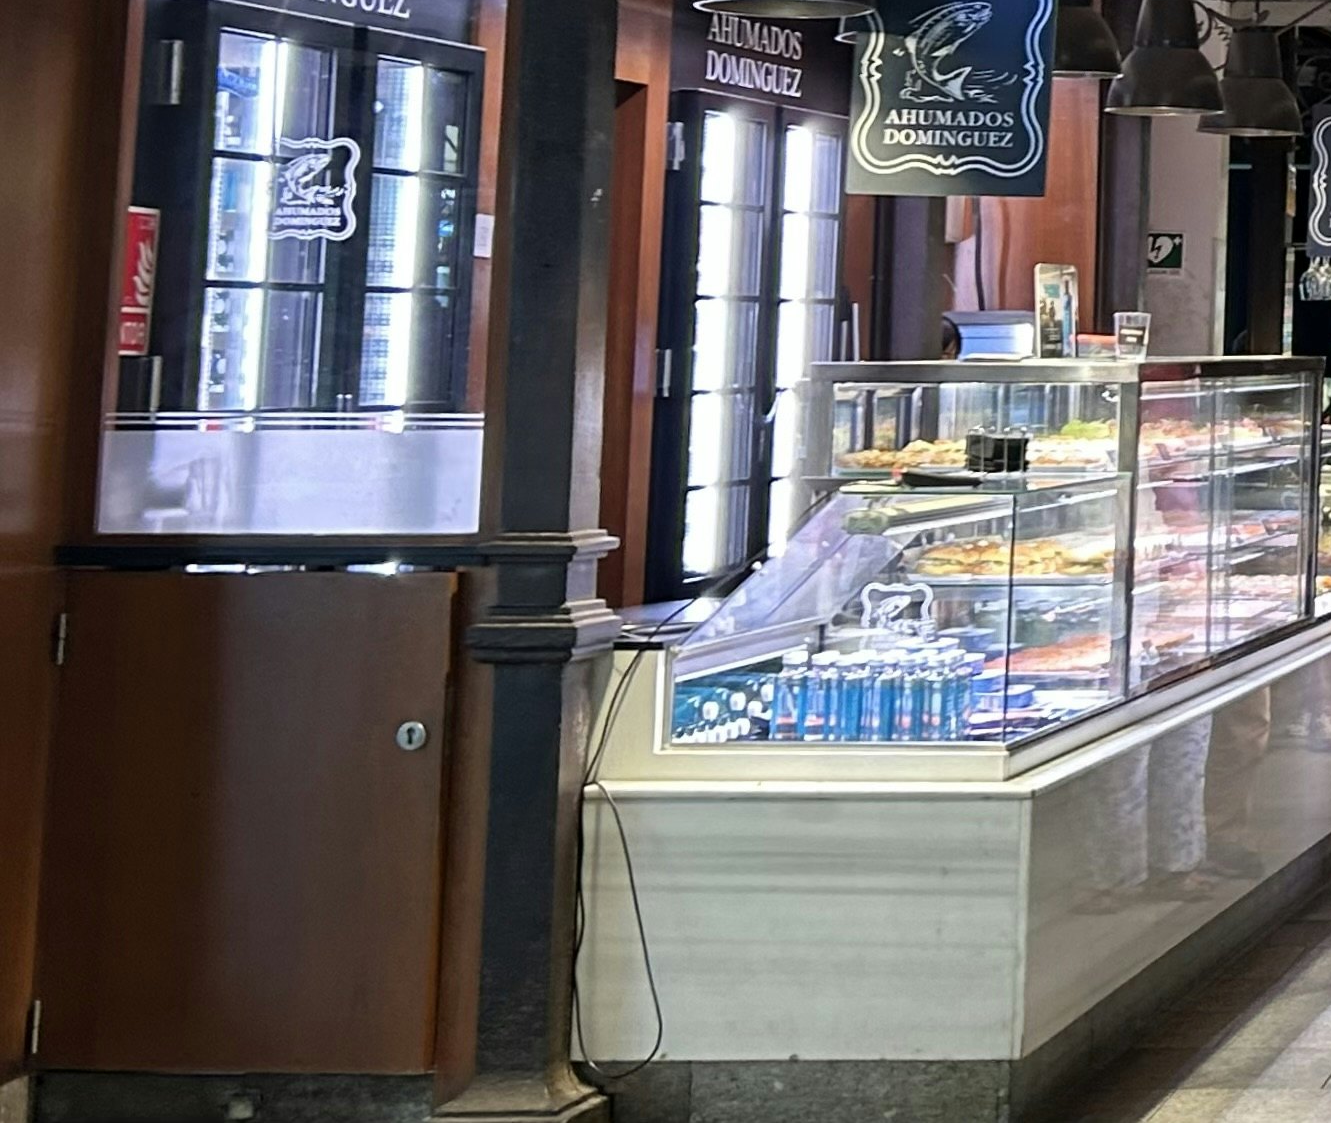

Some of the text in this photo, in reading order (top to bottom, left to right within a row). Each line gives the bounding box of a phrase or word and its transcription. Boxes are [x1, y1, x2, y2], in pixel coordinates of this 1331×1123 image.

[706, 11, 802, 60] AHUMADOS
[705, 49, 802, 97] DOMINGUEZ
[884, 108, 1014, 127] AHUMADOS
[883, 128, 1013, 147] DOMINGUEZ
